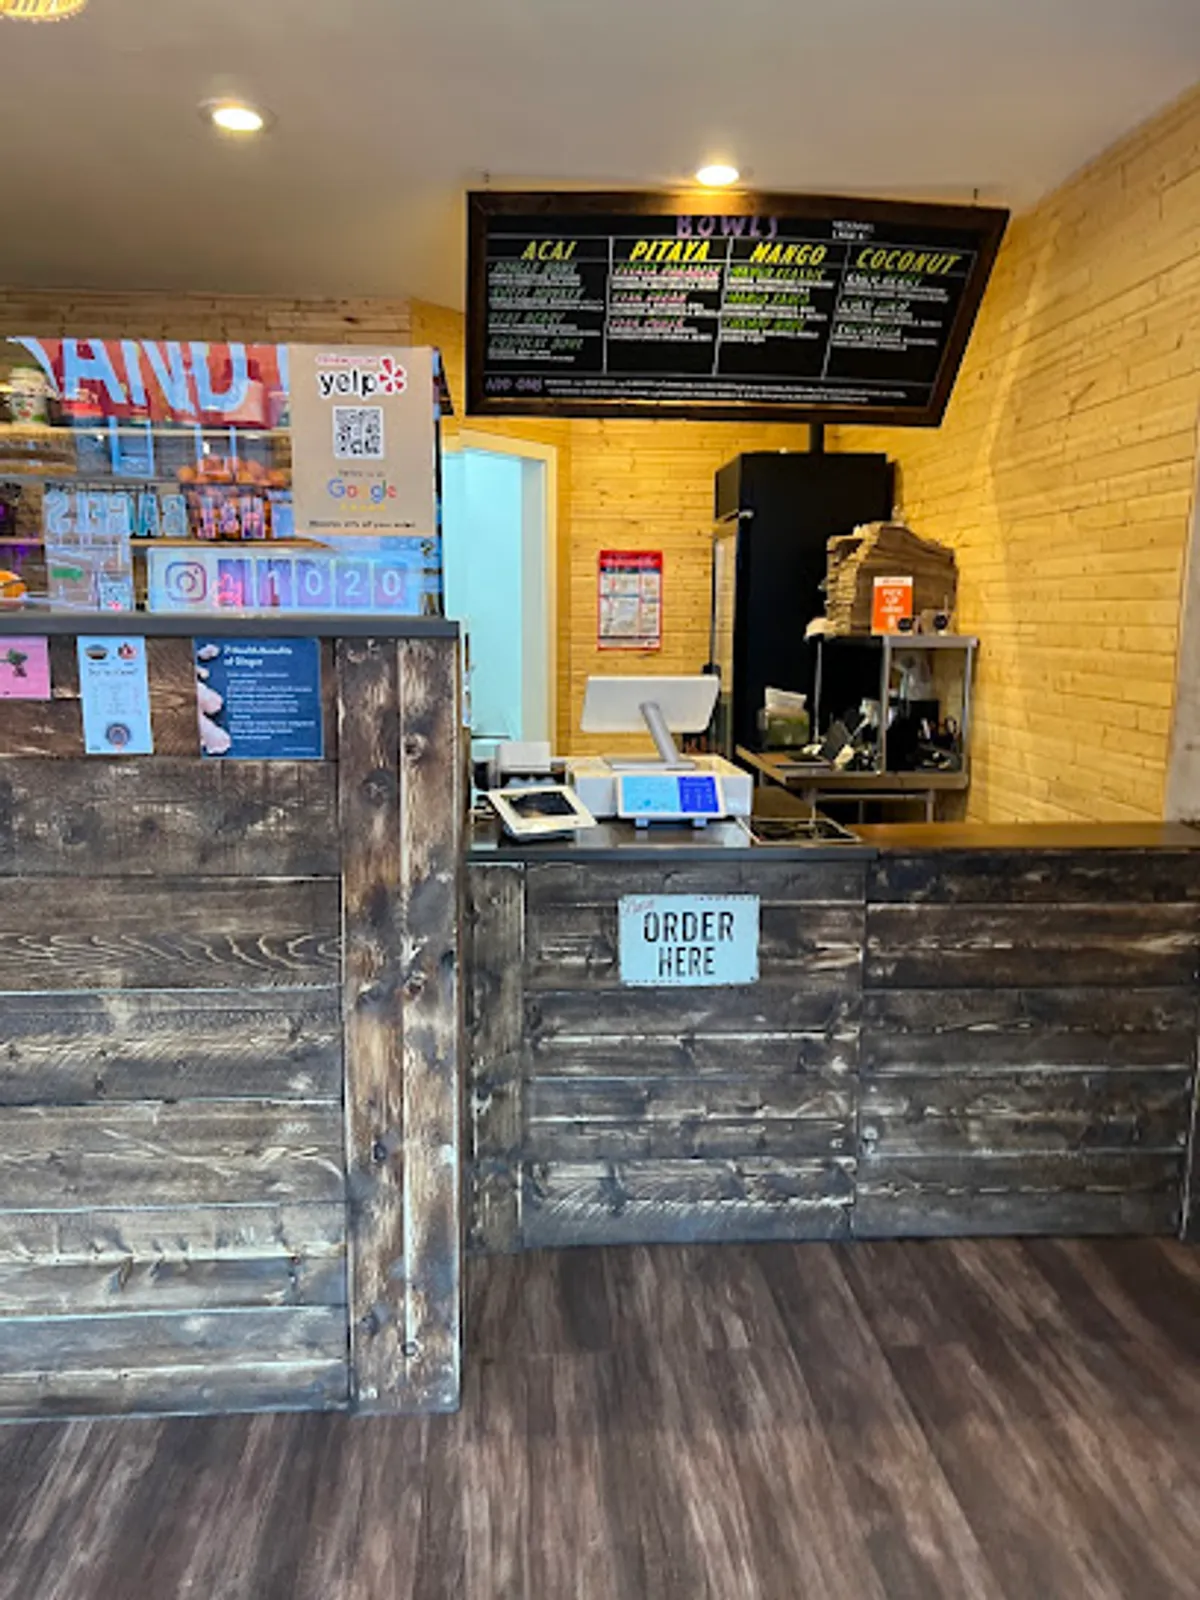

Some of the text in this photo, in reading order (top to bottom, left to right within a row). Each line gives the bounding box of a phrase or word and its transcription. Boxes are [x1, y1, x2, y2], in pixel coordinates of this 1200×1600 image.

[521, 241, 577, 260] ACAI
[629, 241, 711, 261] PITAYA
[750, 242, 827, 265] MANGO
[856, 248, 960, 274] COCONUT
[319, 369, 378, 396] yelp
[327, 478, 397, 504] Google
[643, 911, 735, 943] ORDER
[658, 946, 715, 977] HERE
